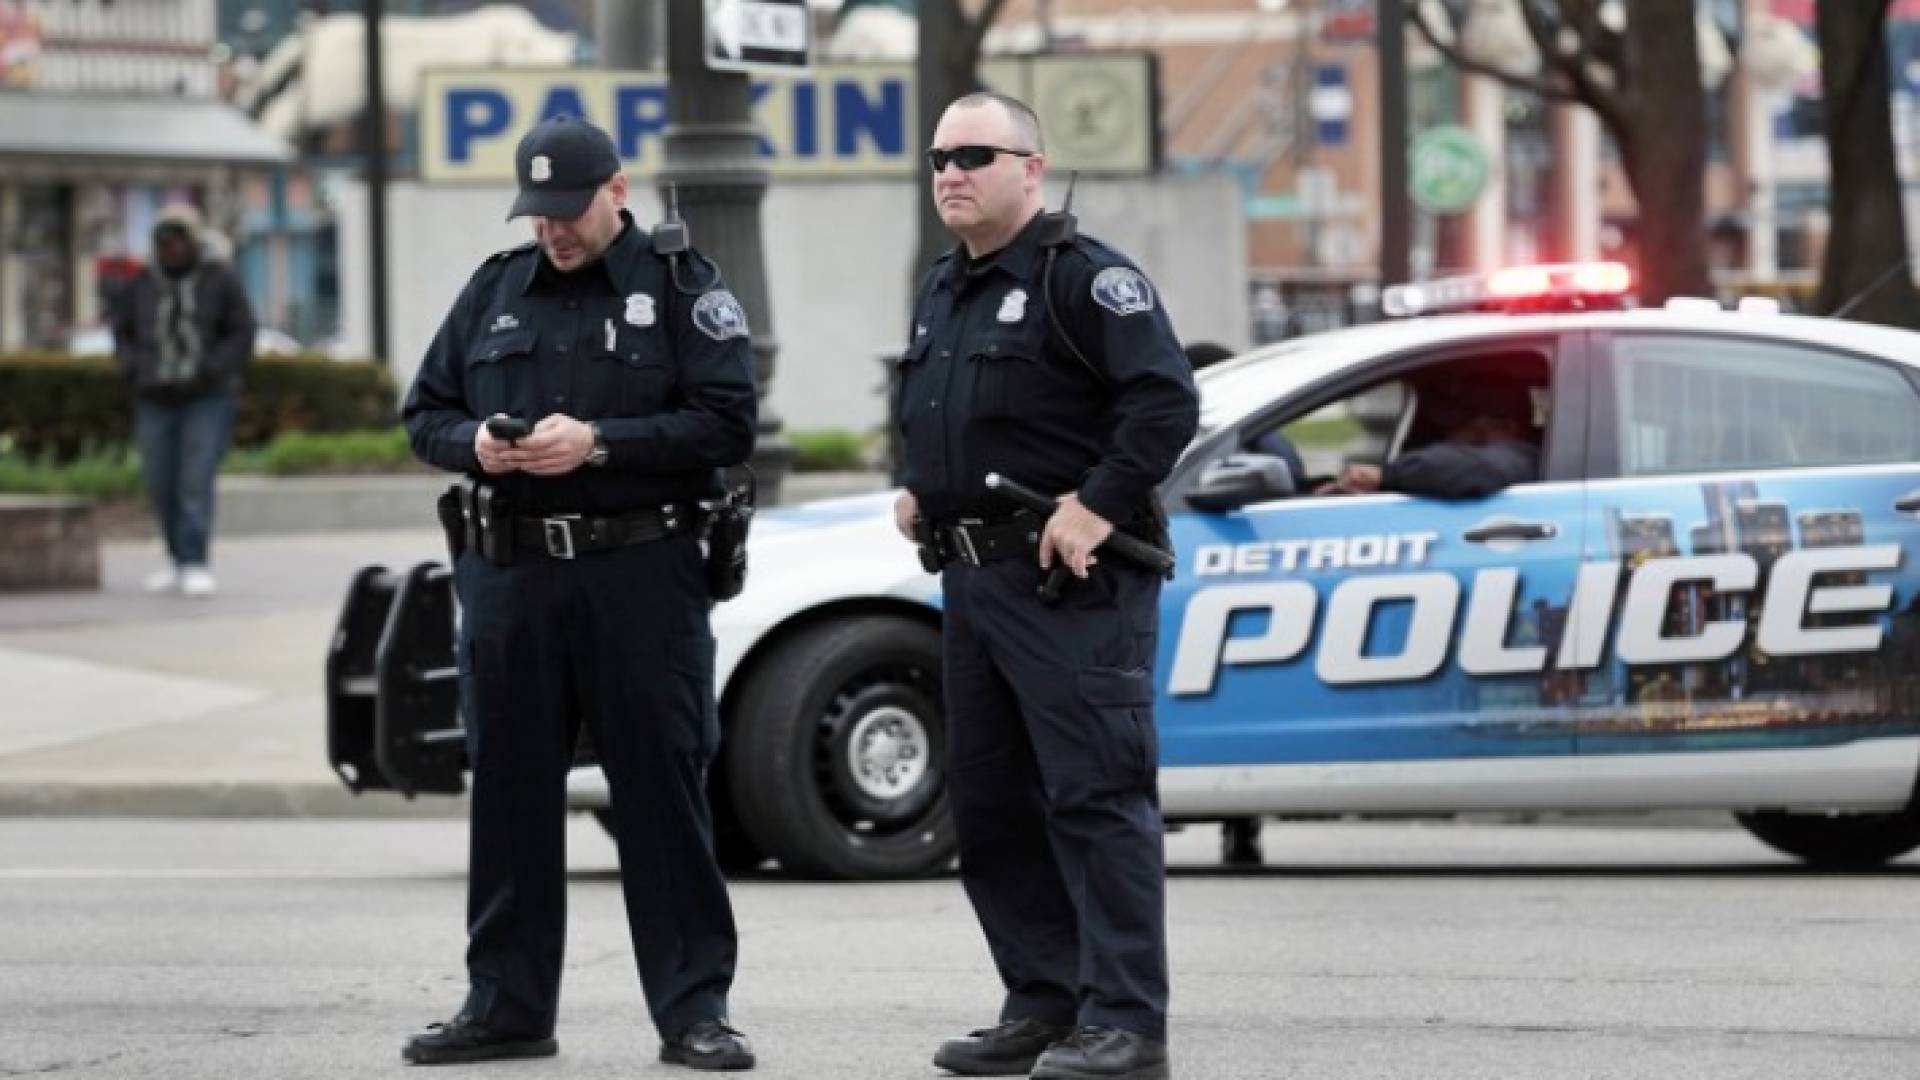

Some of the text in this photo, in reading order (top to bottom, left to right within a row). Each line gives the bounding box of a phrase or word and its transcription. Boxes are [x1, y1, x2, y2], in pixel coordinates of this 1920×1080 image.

[445, 80, 904, 162] PRIN
[1194, 532, 1438, 575] DETROIT
[1168, 546, 1901, 695] POLICE
